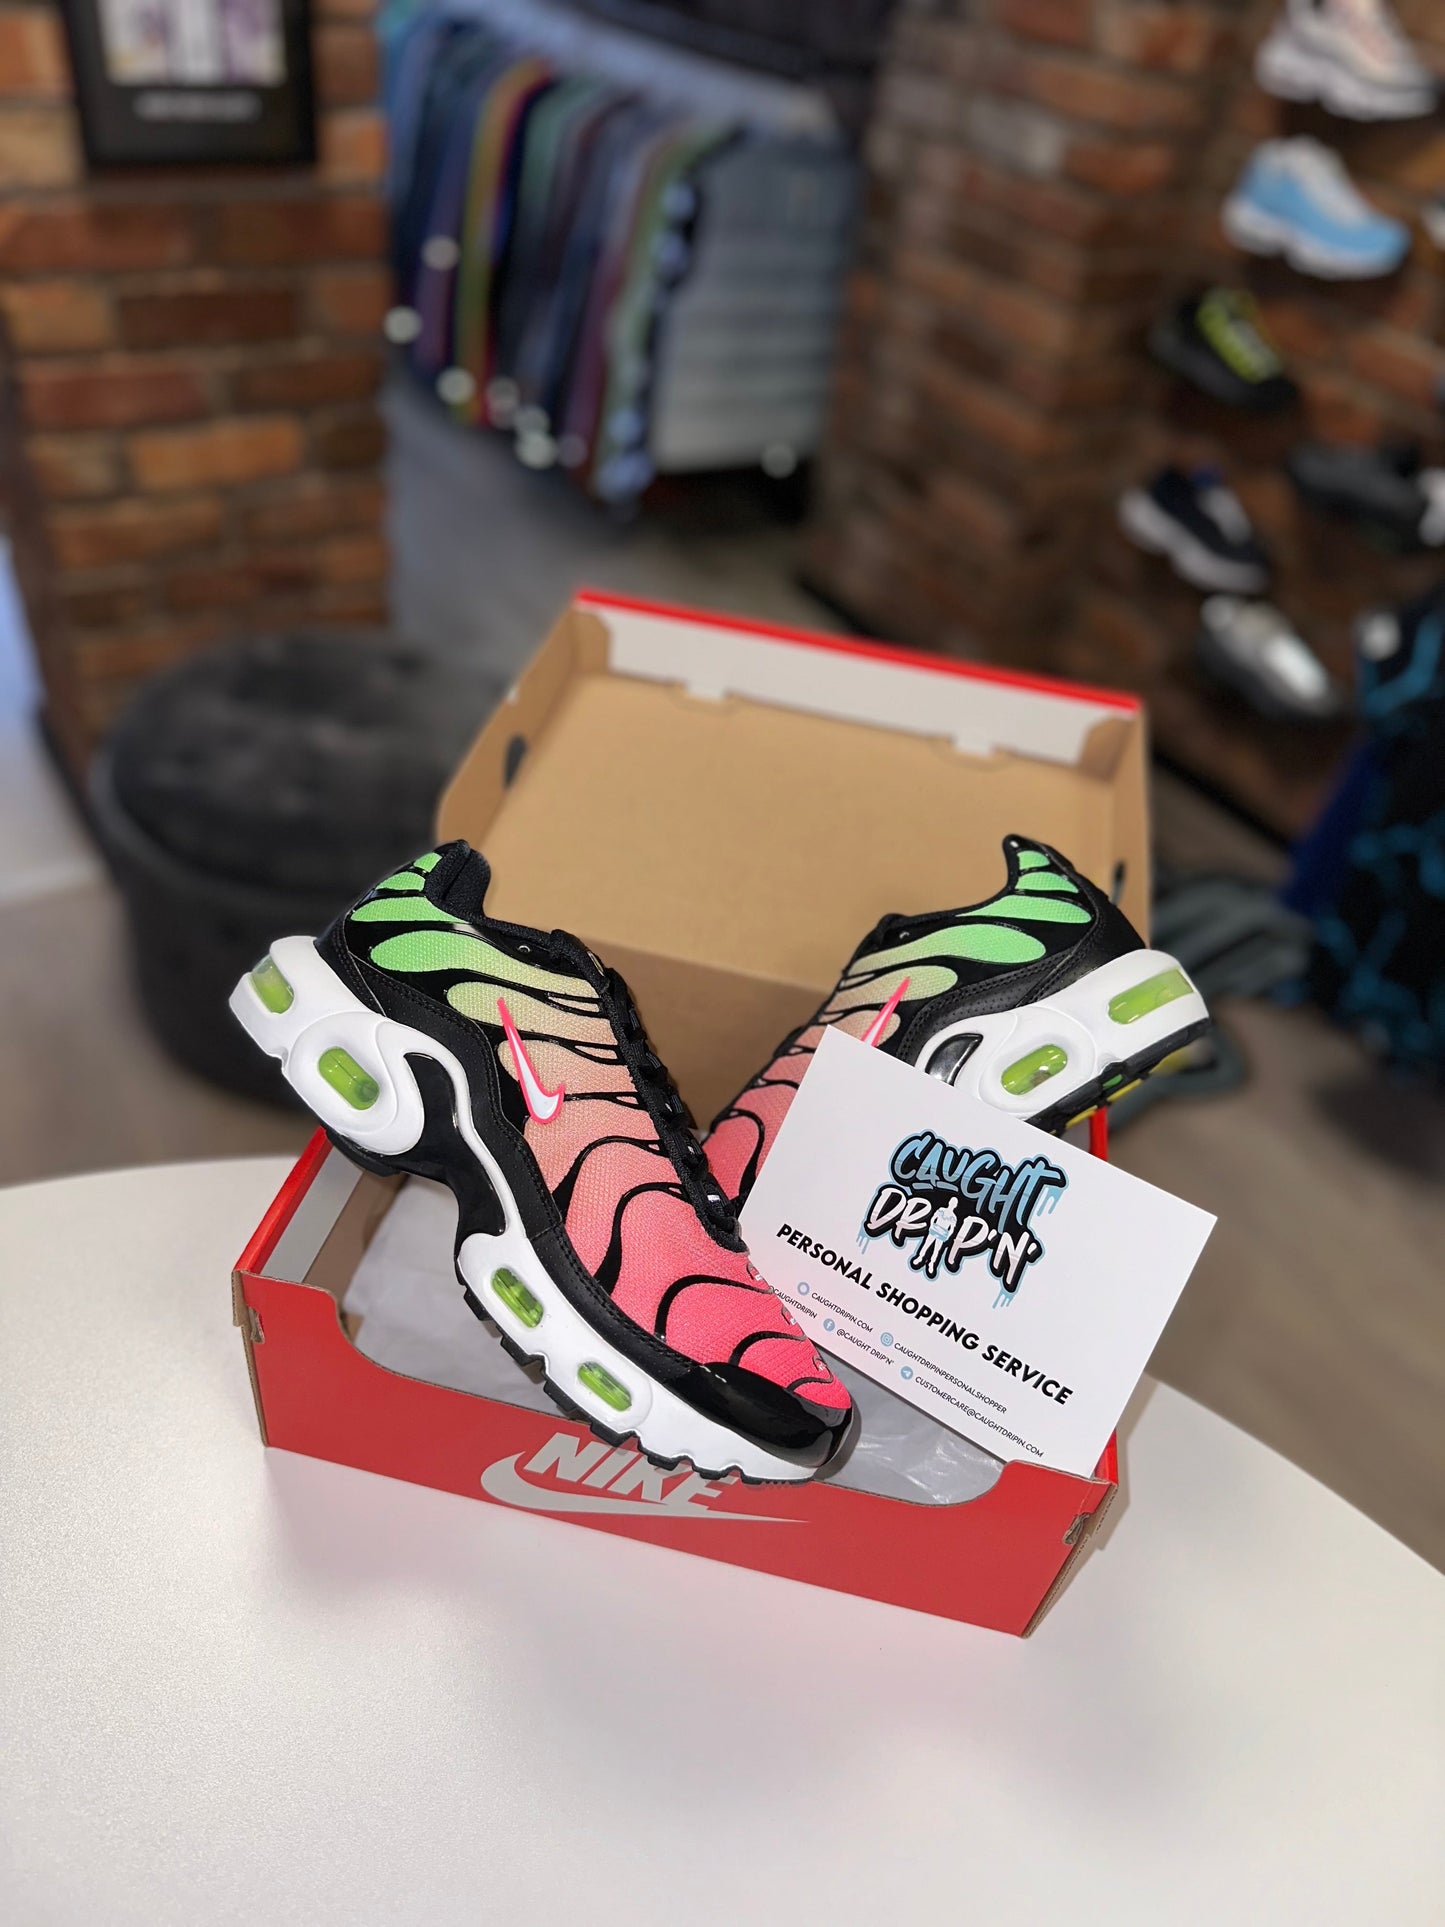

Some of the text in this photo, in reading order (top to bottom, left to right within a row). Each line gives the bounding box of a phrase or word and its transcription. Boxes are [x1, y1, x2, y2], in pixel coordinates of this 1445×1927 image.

[893, 1134, 1061, 1234] CAUGHT
[776, 1223, 1074, 1406] PERSONAL SHOPPING SERVICE
[811, 1292, 874, 1333] CAUGHTDRIPIN.COM
[836, 1328, 871, 1354] @CAUGHT
[894, 1342, 1008, 1415] CAUGHTDRIPINPERSONALSHOPPER
[915, 1376, 1045, 1458] CUSTOMERCARE@CAUGHTDRIPIN.COM
[523, 1431, 741, 1511] NIKE
